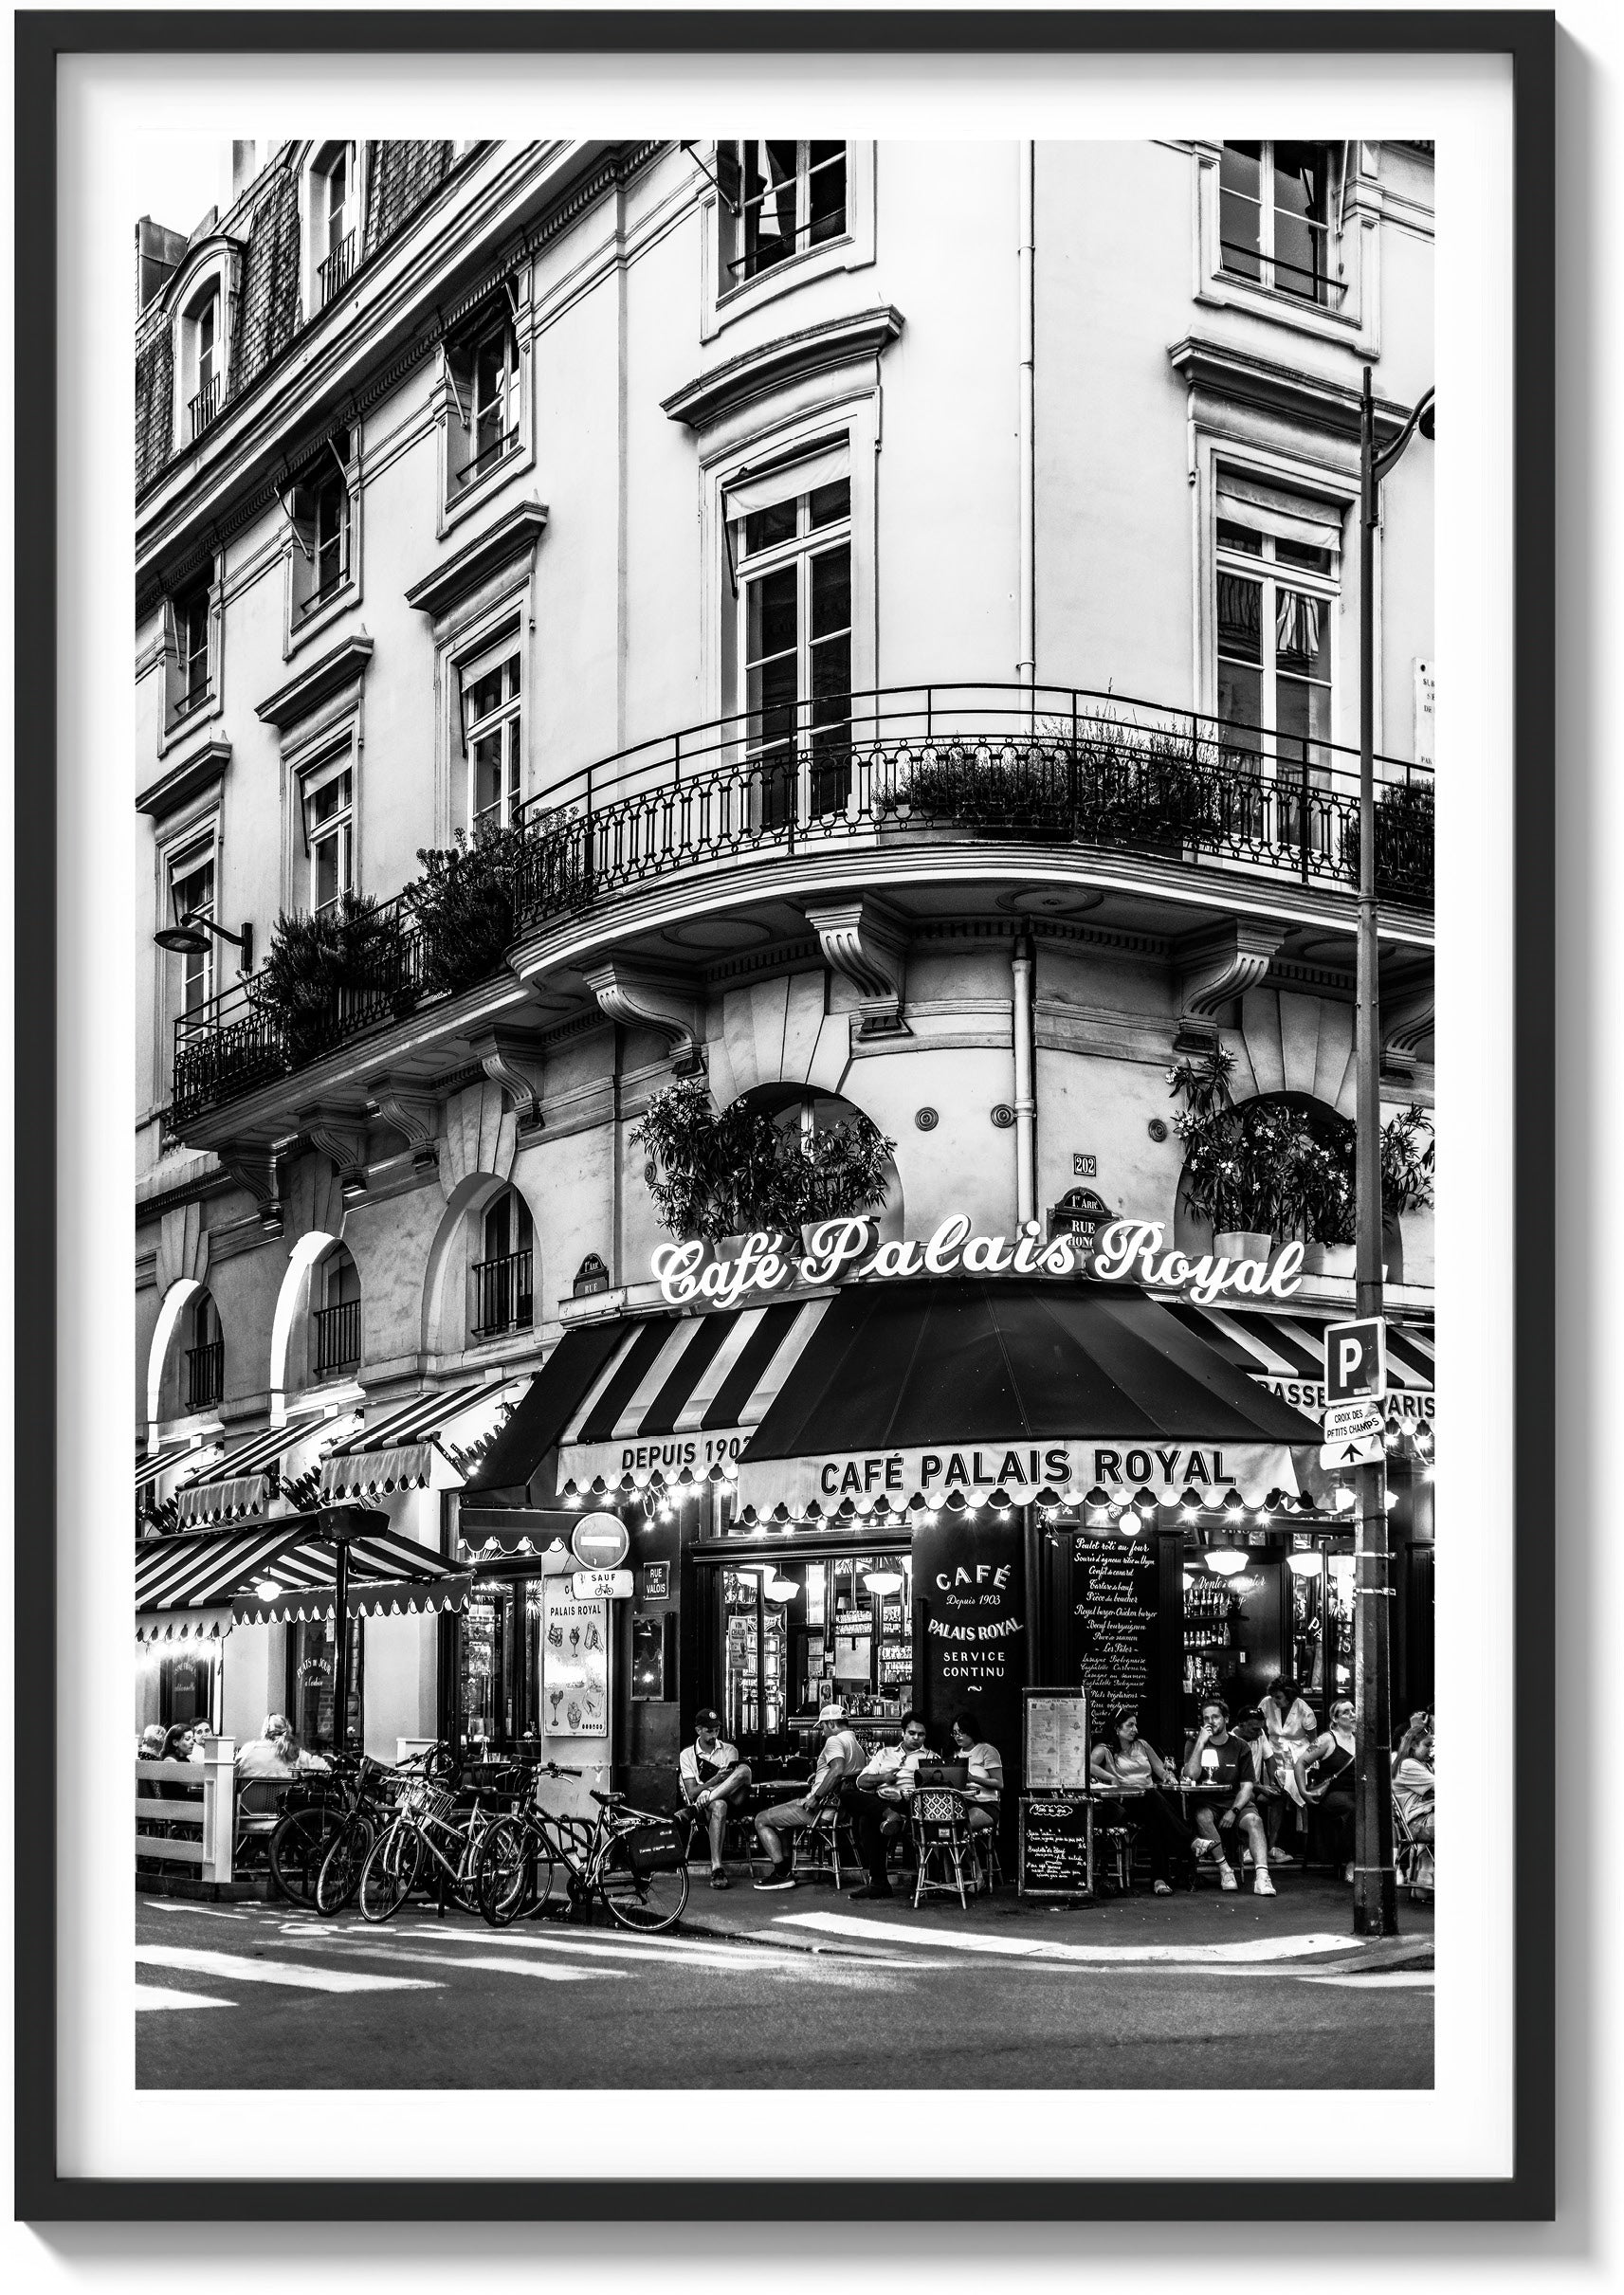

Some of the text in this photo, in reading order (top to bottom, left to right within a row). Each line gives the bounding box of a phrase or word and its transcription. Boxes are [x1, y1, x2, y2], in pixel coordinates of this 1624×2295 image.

[1076, 1157, 1094, 1174] 202
[1071, 1220, 1096, 1234] RUE
[651, 1213, 1305, 1308] Café Palais Royal
[1340, 1338, 1363, 1388] P
[1334, 1409, 1363, 1423] CROIX DES
[1327, 1417, 1379, 1438] PETITS CHAMPS
[622, 1442, 696, 1470] DEPUIS
[820, 1448, 1236, 1494] CAFÉ PALAIS ROYAL
[1075, 1537, 1100, 1549] Poulet
[1101, 1540, 1117, 1550] rôti
[1128, 1539, 1149, 1557] four
[1074, 1553, 1095, 1562] Souris
[591, 1574, 616, 1582] SAUF
[649, 1568, 663, 1578] RUE
[936, 1564, 1012, 1591] CAFÉ
[1088, 1565, 1108, 1580] Confit
[646, 1583, 666, 1594] VALOIS
[1198, 1575, 1223, 1590] Vente
[946, 1594, 1001, 1610] Depuis 1903
[550, 1605, 602, 1616] PALAIS ROYAL
[1074, 1604, 1097, 1619] Royal
[1138, 1607, 1158, 1620] burger
[928, 1617, 1024, 1641] PALAIS ROYAL
[943, 1651, 1006, 1662] SERVICE
[942, 1667, 1005, 1677] CONTINU
